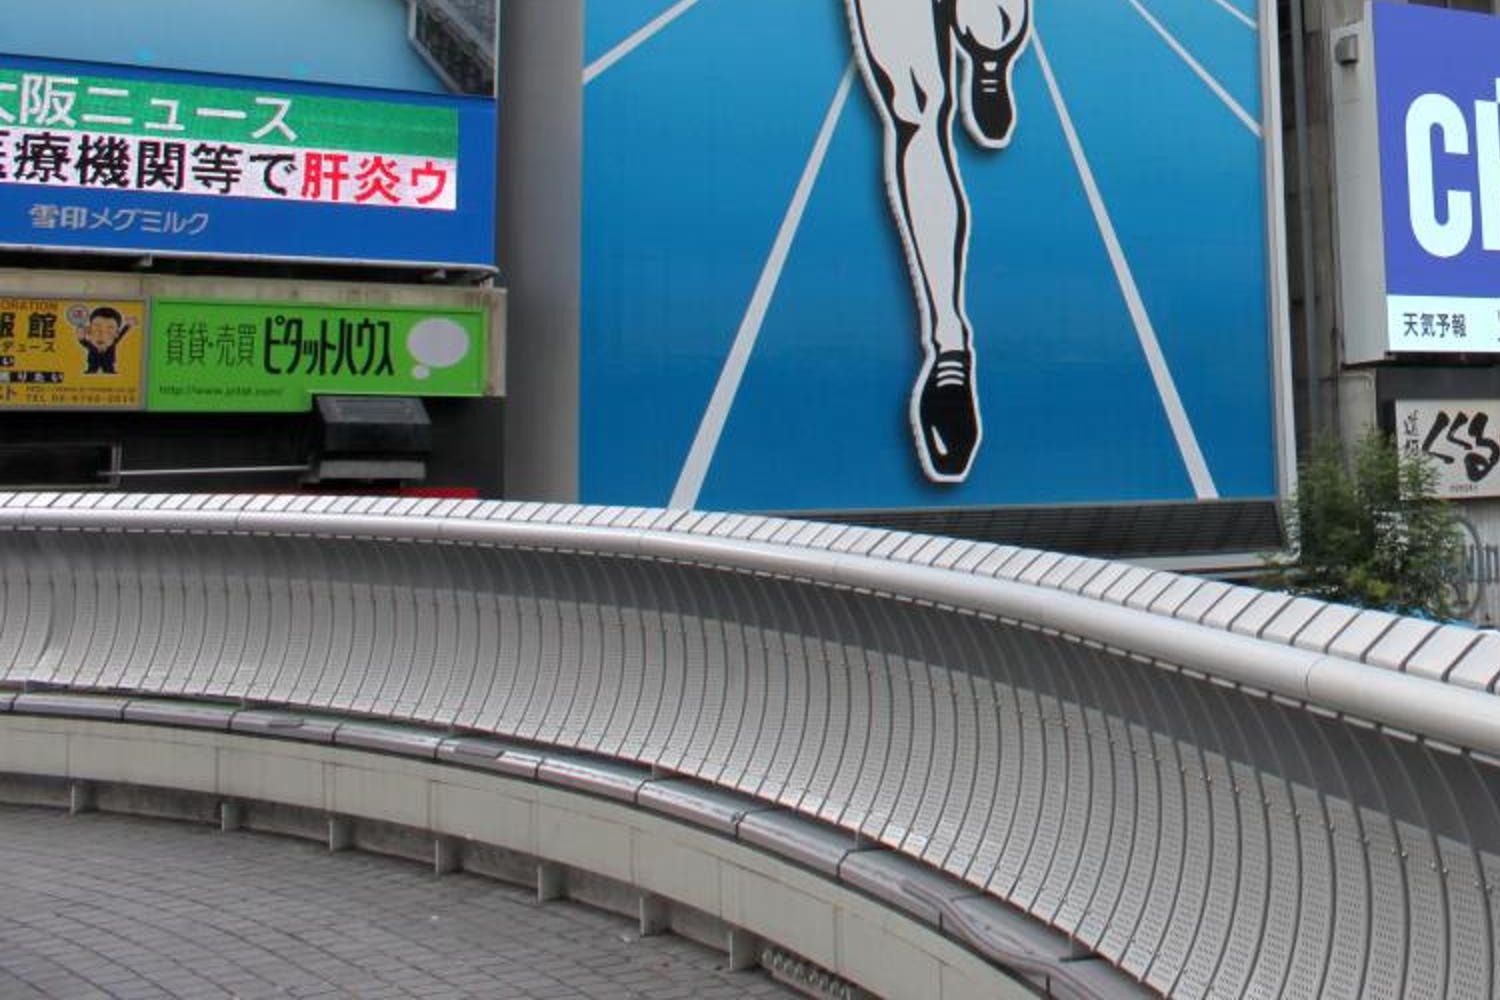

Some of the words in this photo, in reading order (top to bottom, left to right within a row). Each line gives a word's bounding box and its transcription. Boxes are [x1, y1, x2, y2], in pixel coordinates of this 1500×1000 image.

[0, 130, 448, 205] 療機関等で肝炎ウ
[29, 206, 209, 236] 雪印メグミルク
[263, 314, 395, 376] ピタットハウス
[1402, 310, 1467, 340] 天気予報
